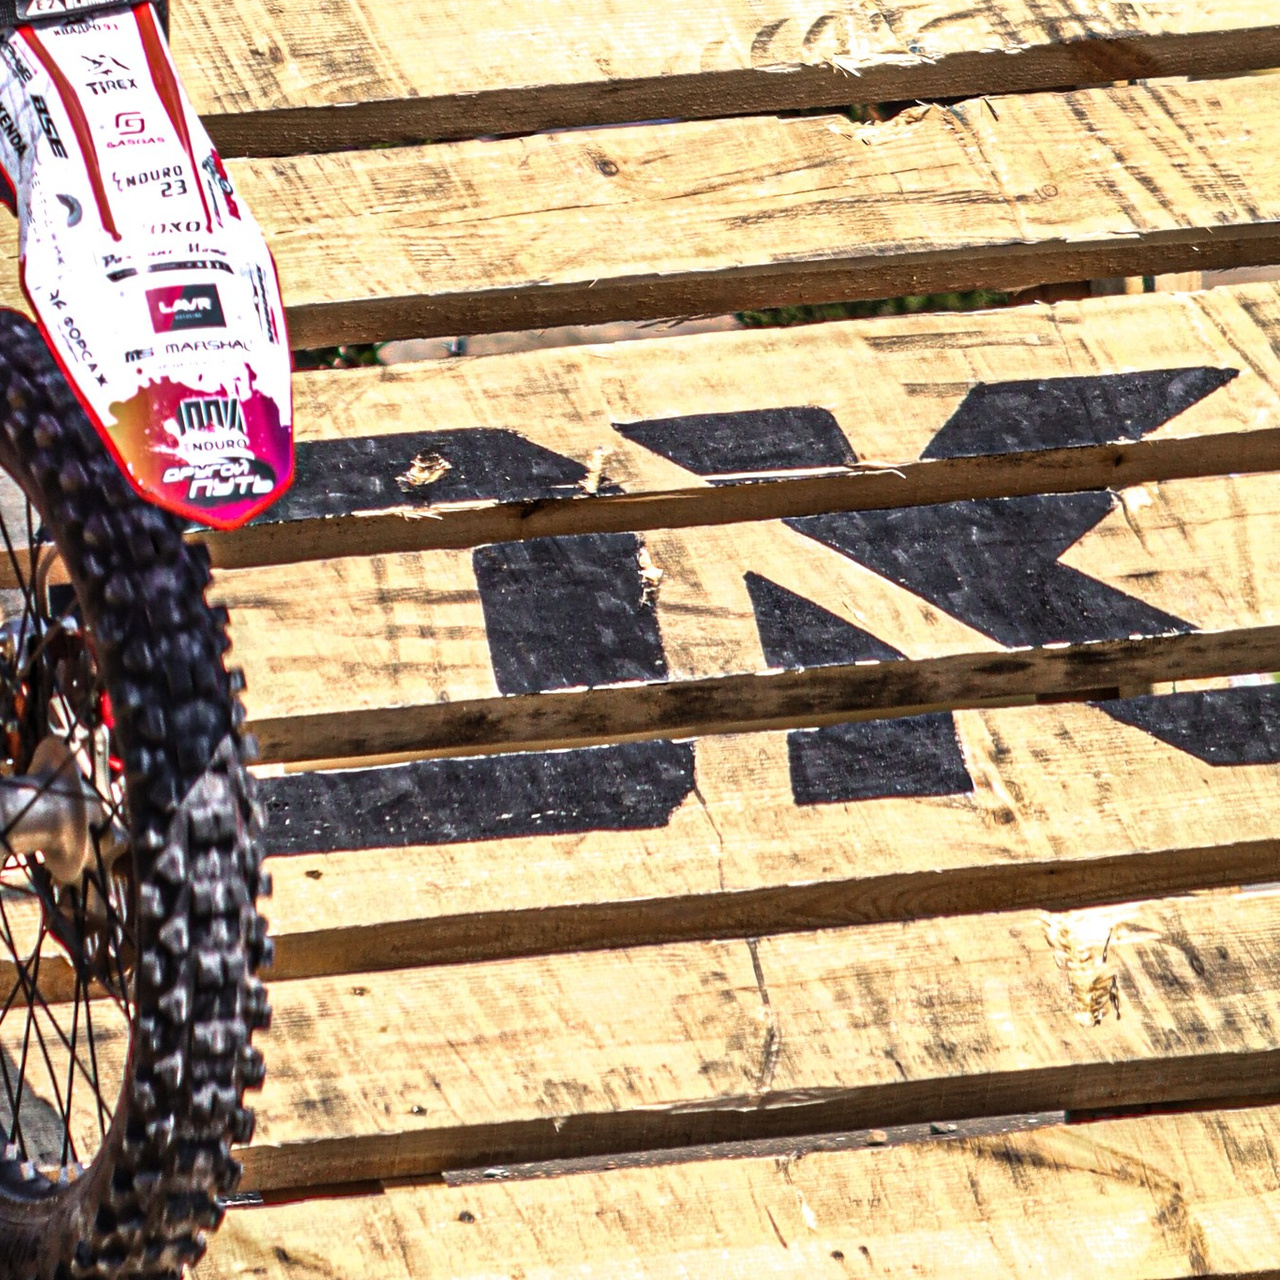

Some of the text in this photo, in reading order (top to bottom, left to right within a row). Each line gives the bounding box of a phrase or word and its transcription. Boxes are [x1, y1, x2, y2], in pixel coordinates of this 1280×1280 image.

[86, 78, 138, 96] TIREX
[31, 93, 68, 160] BSE
[106, 137, 165, 149] GASGAS
[161, 180, 188, 198] 23
[158, 297, 212, 315] LAVR
[64, 316, 109, 389] ФОРСАЖ
[162, 458, 250, 483] ДРУГОЙ
[189, 474, 274, 500] ПУТЬ
